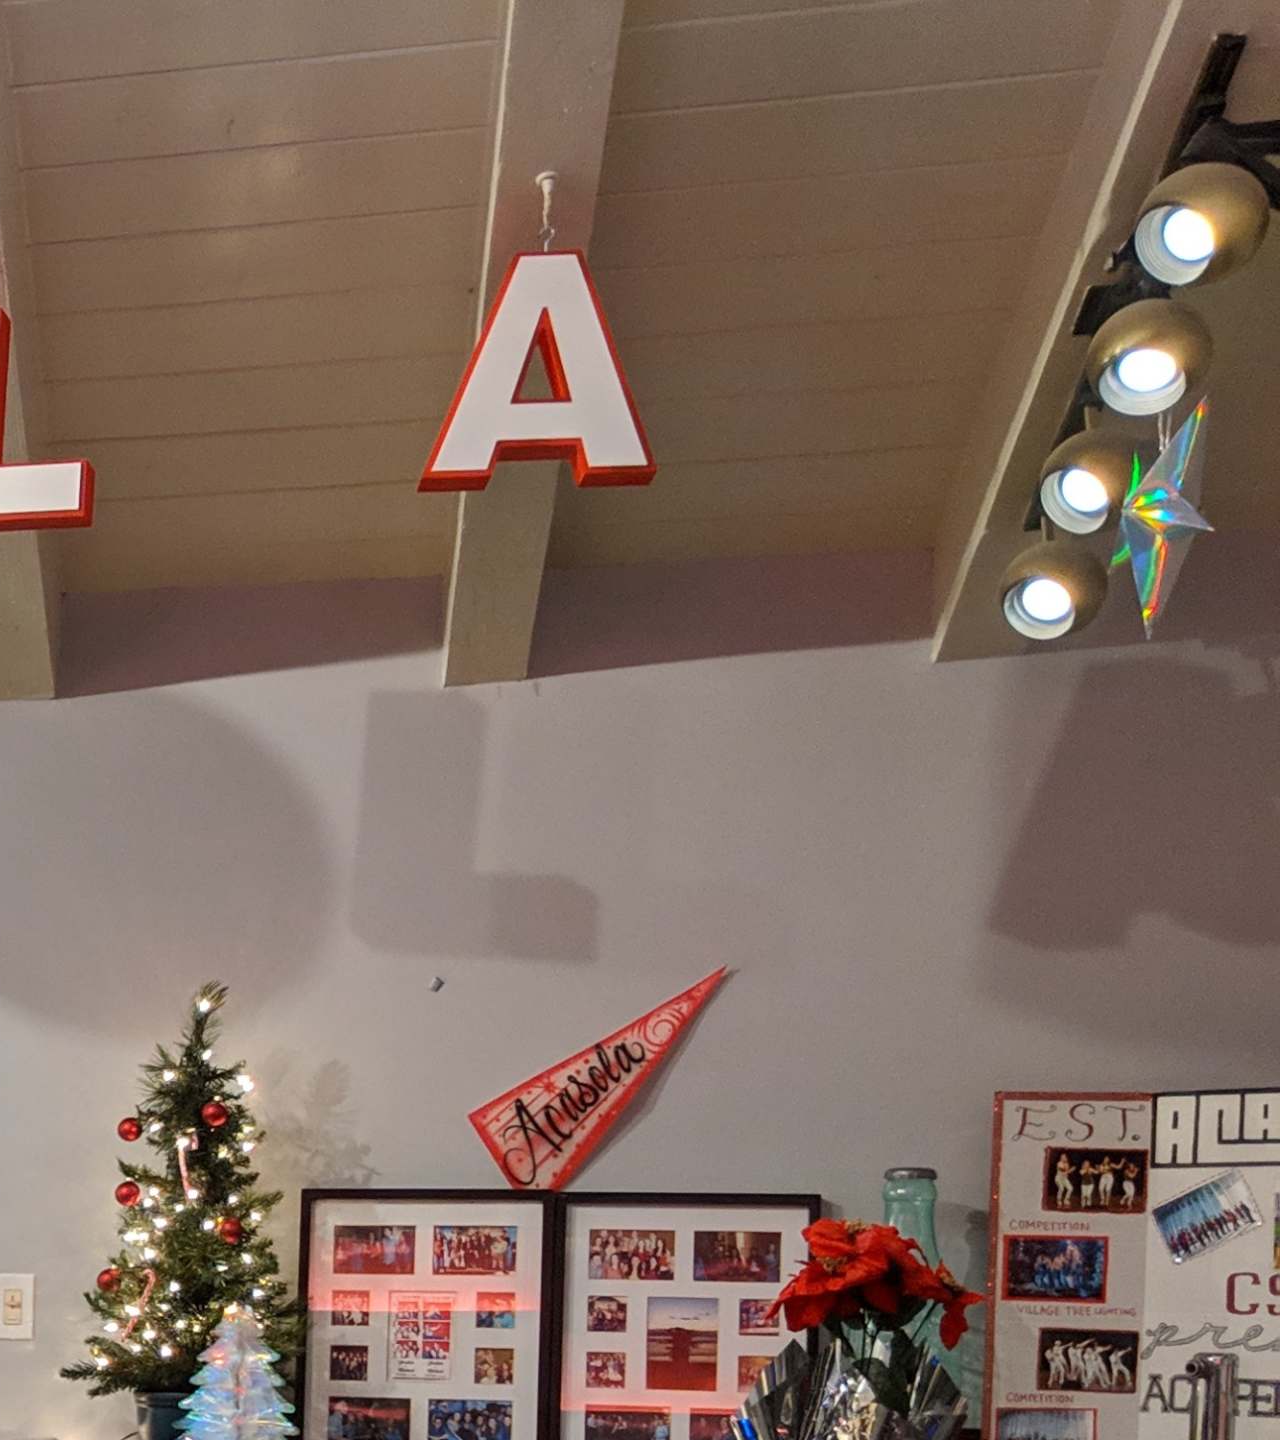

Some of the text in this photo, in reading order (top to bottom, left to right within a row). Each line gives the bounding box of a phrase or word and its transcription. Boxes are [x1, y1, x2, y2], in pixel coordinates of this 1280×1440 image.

[502, 1041, 647, 1186] Acasola
[1009, 1219, 1091, 1231] COMPETITION
[1016, 1304, 1059, 1316] VILLAGE
[1065, 1305, 1091, 1317] TREE
